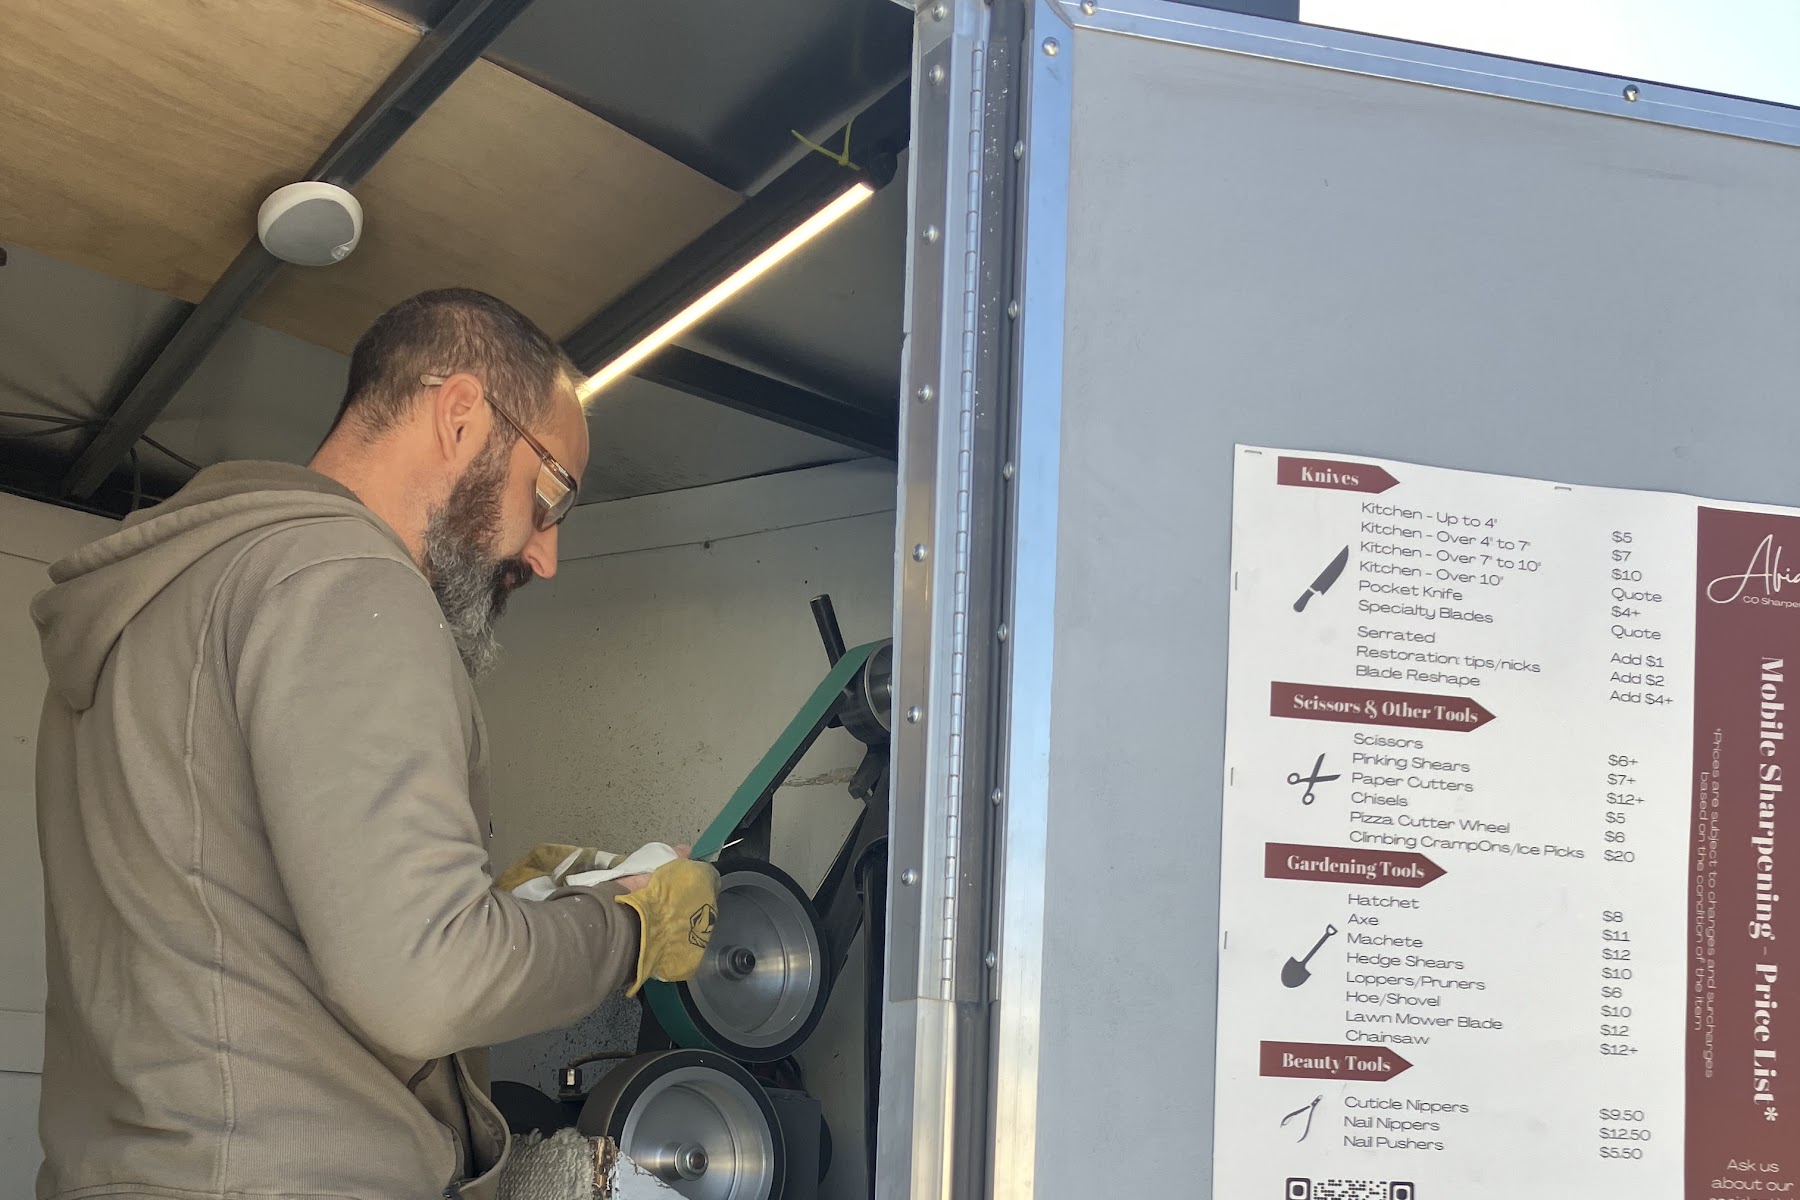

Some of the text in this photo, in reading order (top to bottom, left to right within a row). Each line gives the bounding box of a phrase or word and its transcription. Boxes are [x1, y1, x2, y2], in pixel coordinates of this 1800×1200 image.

[1301, 466, 1359, 486] Knives
[1361, 501, 1423, 520] Kitchen
[1436, 511, 1459, 527] Up
[1461, 515, 1481, 528] to
[1360, 521, 1423, 539] Kitchen
[1436, 530, 1477, 545] Over
[1495, 537, 1515, 551] to
[1611, 530, 1633, 544] $5
[1360, 540, 1423, 559] Kitchen
[1436, 549, 1477, 564] Over
[1495, 557, 1515, 569] to
[1611, 549, 1633, 563] $7
[1359, 560, 1422, 577] Kitchen
[1435, 568, 1477, 583] Over
[1611, 567, 1643, 583] $10
[1358, 579, 1463, 601] Pocket Knife
[1611, 587, 1663, 603] Quote
[1358, 599, 1494, 624] Specialty Blades
[1761, 597, 1800, 608] Sharpe
[1611, 605, 1641, 619] $4+
[1357, 625, 1436, 644] Serrated
[1610, 624, 1662, 641] Quote
[1463, 655, 1541, 673] tips/nicks
[1609, 652, 1665, 669] Add $1
[1355, 664, 1481, 688] Blade Reshape
[1609, 671, 1665, 687] Add $2
[1609, 689, 1675, 706] Add $4+
[1759, 656, 1785, 757] Mobile
[1293, 693, 1479, 723] Scissors & Other Tools
[1353, 732, 1425, 750] Scissors
[1352, 752, 1471, 773] Pinking Shears
[1607, 753, 1639, 768] $6+
[1351, 771, 1475, 793] Paper Cutters
[1606, 773, 1637, 786] $7+
[1351, 791, 1409, 807] Chisels
[1605, 791, 1645, 806] $12+
[1699, 772, 1710, 821] based
[1711, 780, 1720, 808] are
[1349, 810, 1511, 834] Pizza Cutter Wheel
[1605, 811, 1626, 825] $5
[1603, 830, 1626, 844] $6
[1698, 823, 1707, 843] on
[1708, 811, 1720, 867] subject
[1349, 830, 1585, 859] Climbing CrampOns/Ice Picks
[1749, 763, 1783, 941] Sharpening
[1603, 849, 1635, 863] $20
[1697, 847, 1706, 872] the
[1287, 854, 1425, 880] Gardening Tools
[1708, 871, 1718, 889] to
[1347, 893, 1420, 910] Hatchet
[1695, 875, 1705, 943] condition
[1347, 913, 1380, 927] Axe
[1601, 909, 1624, 923] $8
[1705, 891, 1718, 956] changes
[1347, 932, 1423, 949] Machete
[1601, 929, 1631, 943] $11
[1346, 951, 1465, 971] Hedge Shears
[1601, 947, 1632, 961] $12
[1695, 946, 1705, 964] of
[1346, 971, 1487, 991] Loppers/Pruners
[1601, 967, 1633, 981] $10
[1695, 968, 1704, 993] the
[1707, 958, 1717, 989] and
[1345, 990, 1441, 1007] Hoe/Shovel
[1600, 985, 1623, 999] $6
[1600, 1004, 1633, 1019] $10
[1753, 963, 1778, 1042] Price
[1345, 1010, 1503, 1030] Lawn Mower Blade
[1345, 1029, 1431, 1045] Chainsaw
[1599, 1023, 1630, 1037] $12
[1703, 991, 1716, 1078] surcharges
[1599, 1043, 1639, 1057] $12+
[1283, 1053, 1391, 1075] Beauty Tools
[1344, 1095, 1469, 1115] Cuticle Nippers
[1598, 1107, 1645, 1122] $9.50
[1343, 1115, 1441, 1133] Nail Nippers
[1343, 1135, 1445, 1151] Nail Pushers
[1598, 1145, 1644, 1160] $5.50
[1727, 1159, 1780, 1173] Ask us
[1711, 1177, 1794, 1192] about our
